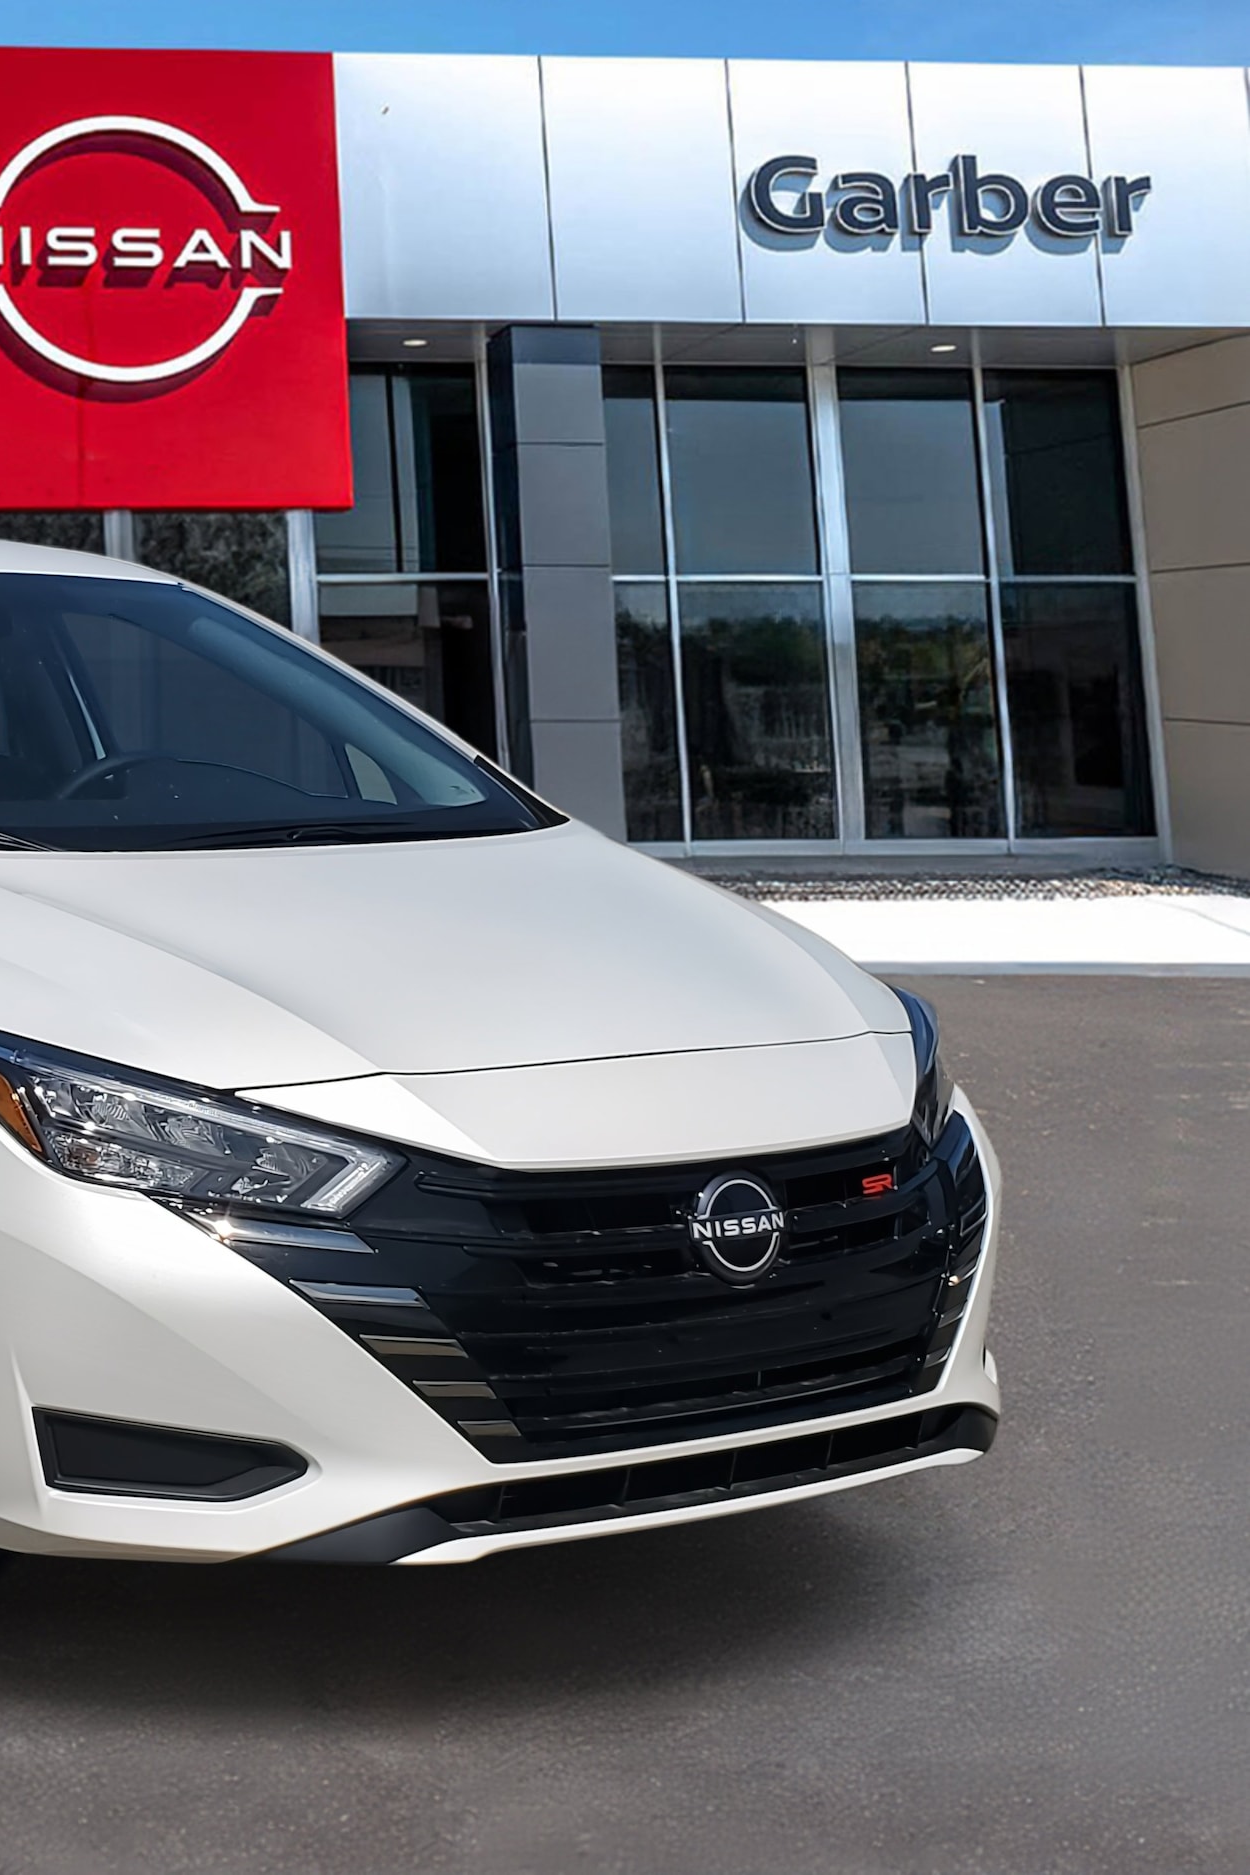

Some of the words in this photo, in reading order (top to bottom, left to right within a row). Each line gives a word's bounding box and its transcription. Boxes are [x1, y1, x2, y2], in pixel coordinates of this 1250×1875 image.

[749, 153, 1152, 238] Garber
[861, 1173, 894, 1195] SR
[692, 1211, 785, 1239] NISSAN
